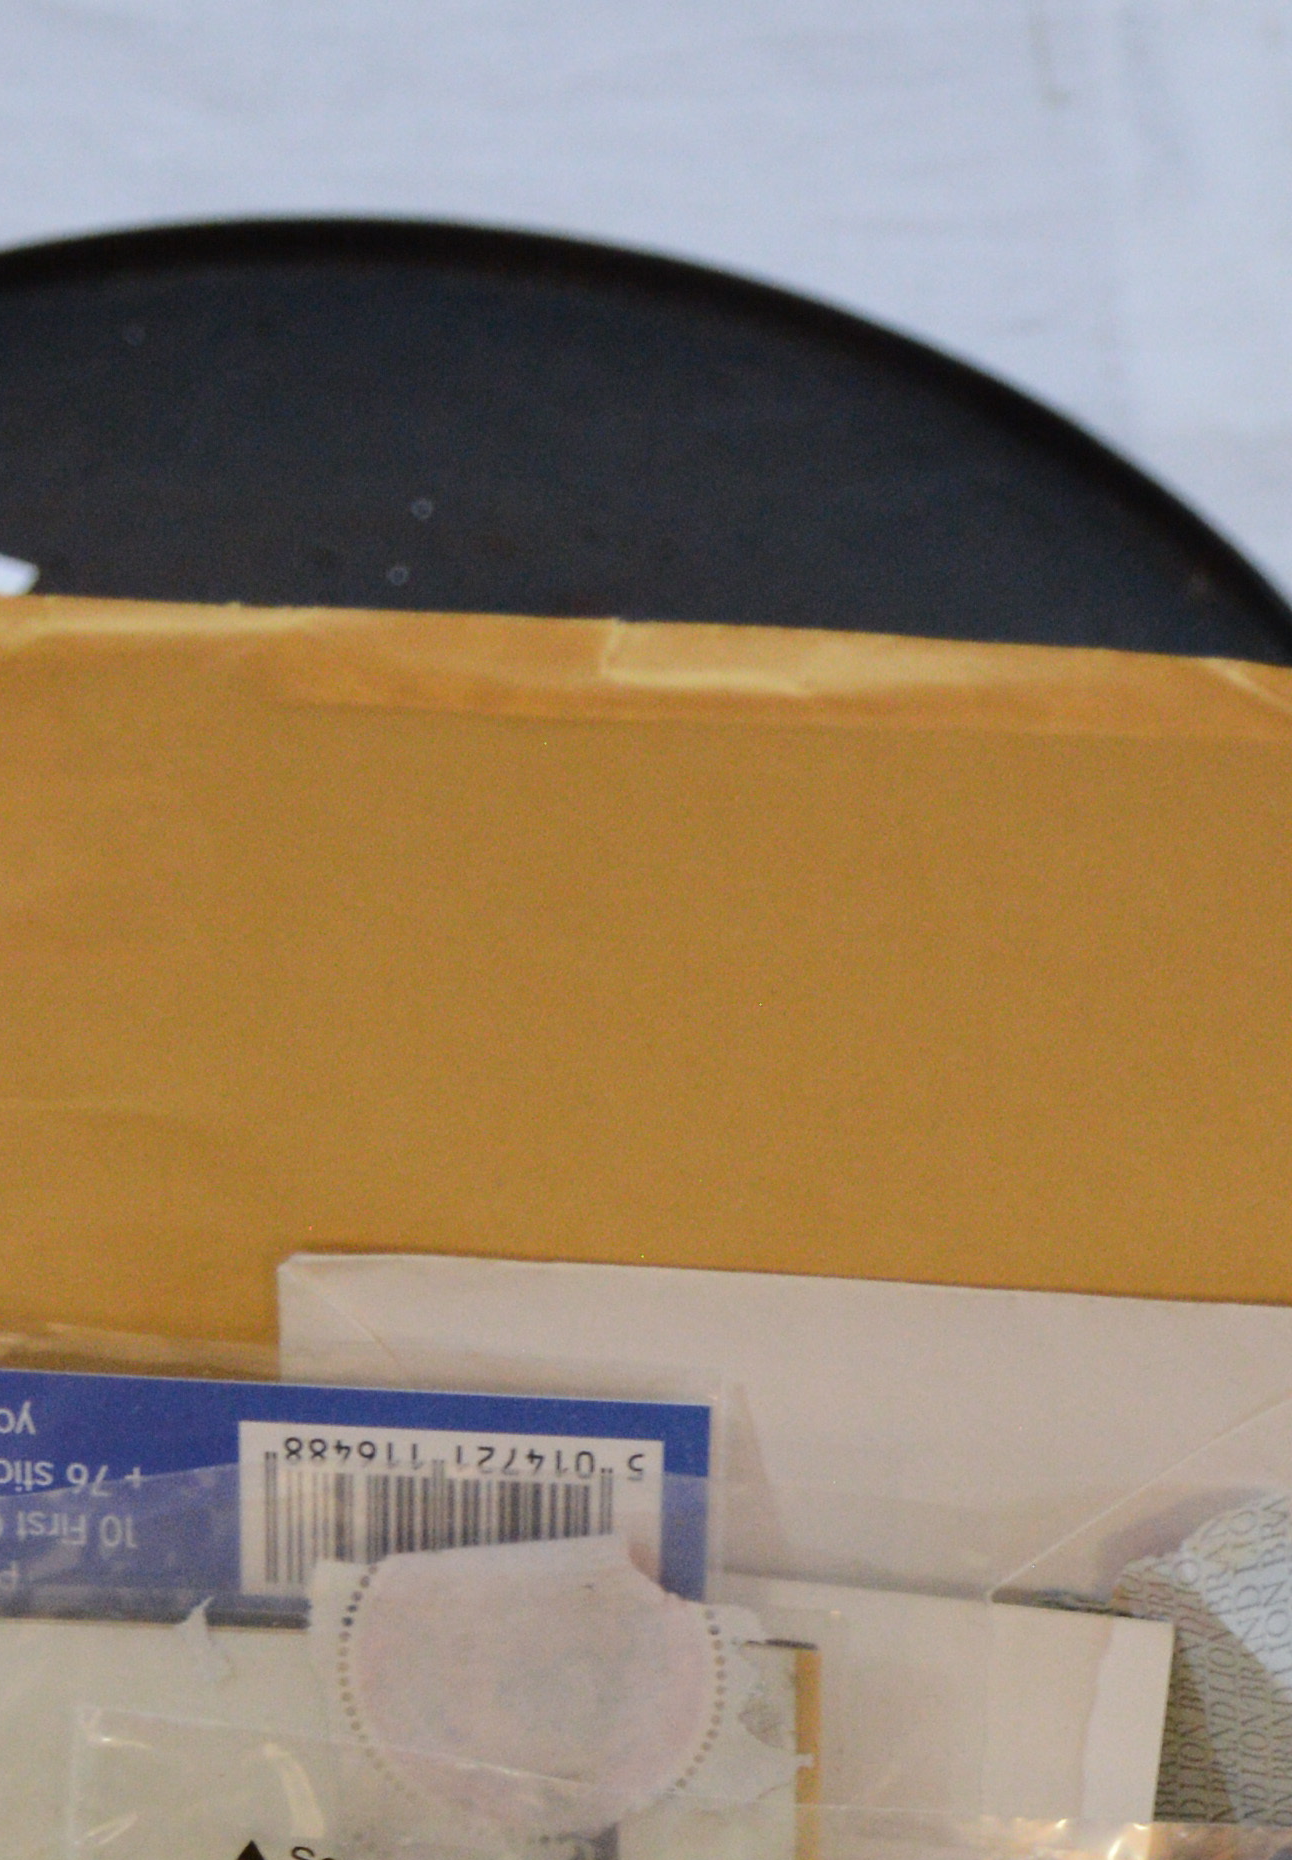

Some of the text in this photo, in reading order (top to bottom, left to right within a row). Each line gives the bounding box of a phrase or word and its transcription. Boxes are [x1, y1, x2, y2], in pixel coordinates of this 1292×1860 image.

[282, 1436, 647, 1482] 5 014721 116488
[65, 1461, 114, 1497] 76
[124, 1465, 143, 1490] +
[16, 1509, 89, 1546] First
[99, 1513, 138, 1549] 10
